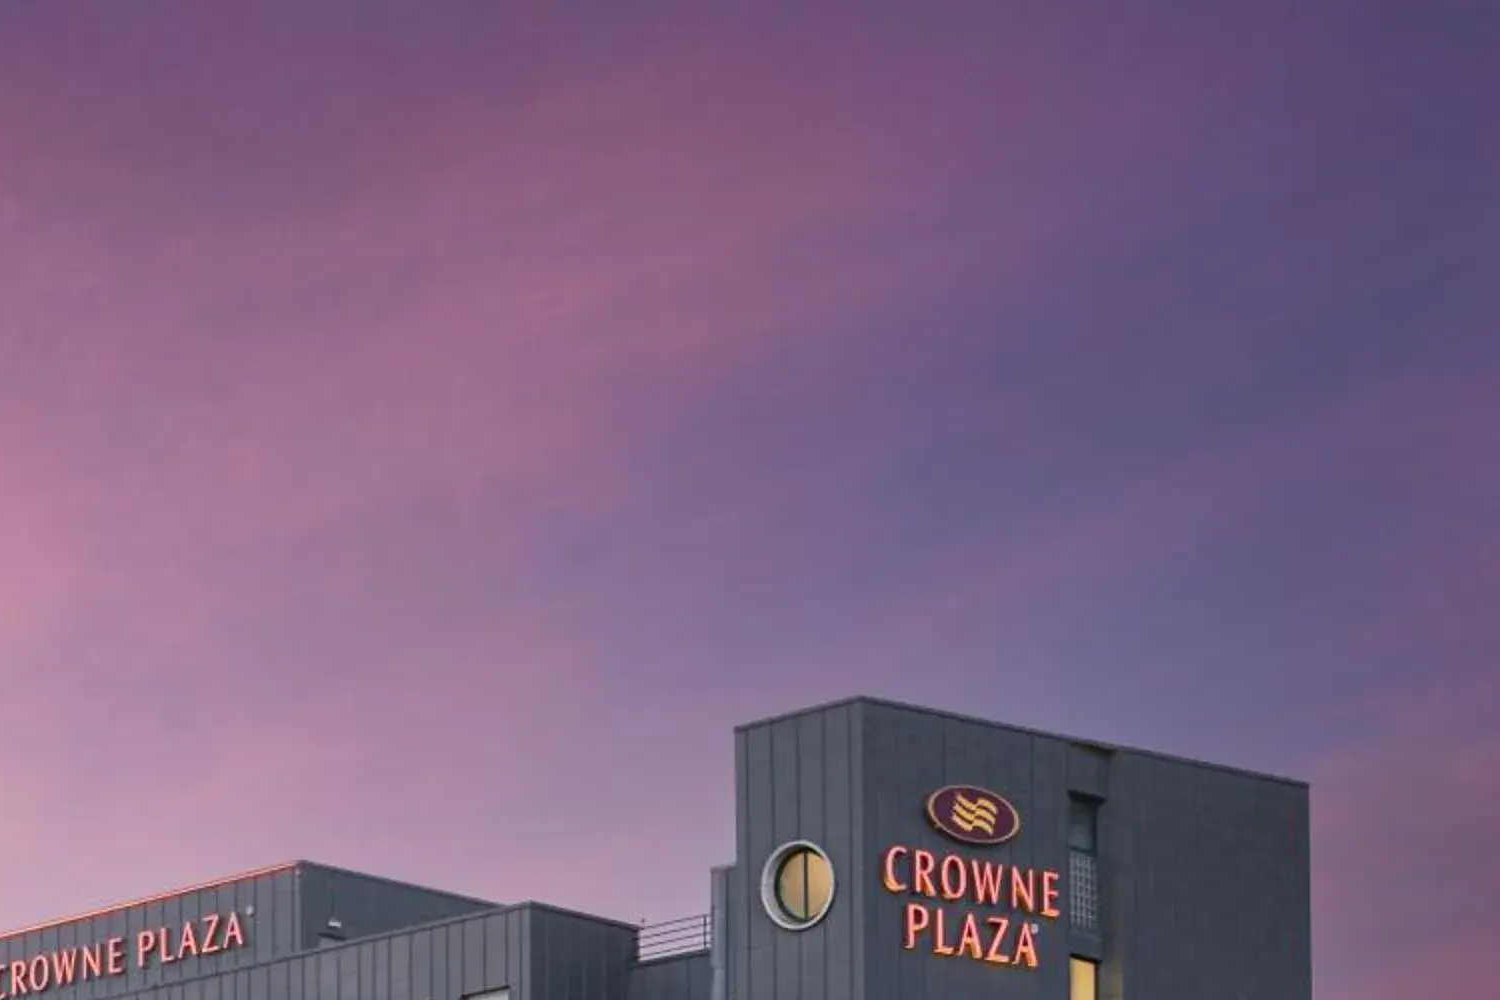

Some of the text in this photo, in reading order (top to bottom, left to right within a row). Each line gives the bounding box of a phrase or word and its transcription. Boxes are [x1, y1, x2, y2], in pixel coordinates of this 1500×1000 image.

[883, 845, 1061, 918] CROWNE
[136, 910, 244, 968] PLAZA
[904, 902, 1039, 967] PLAZA
